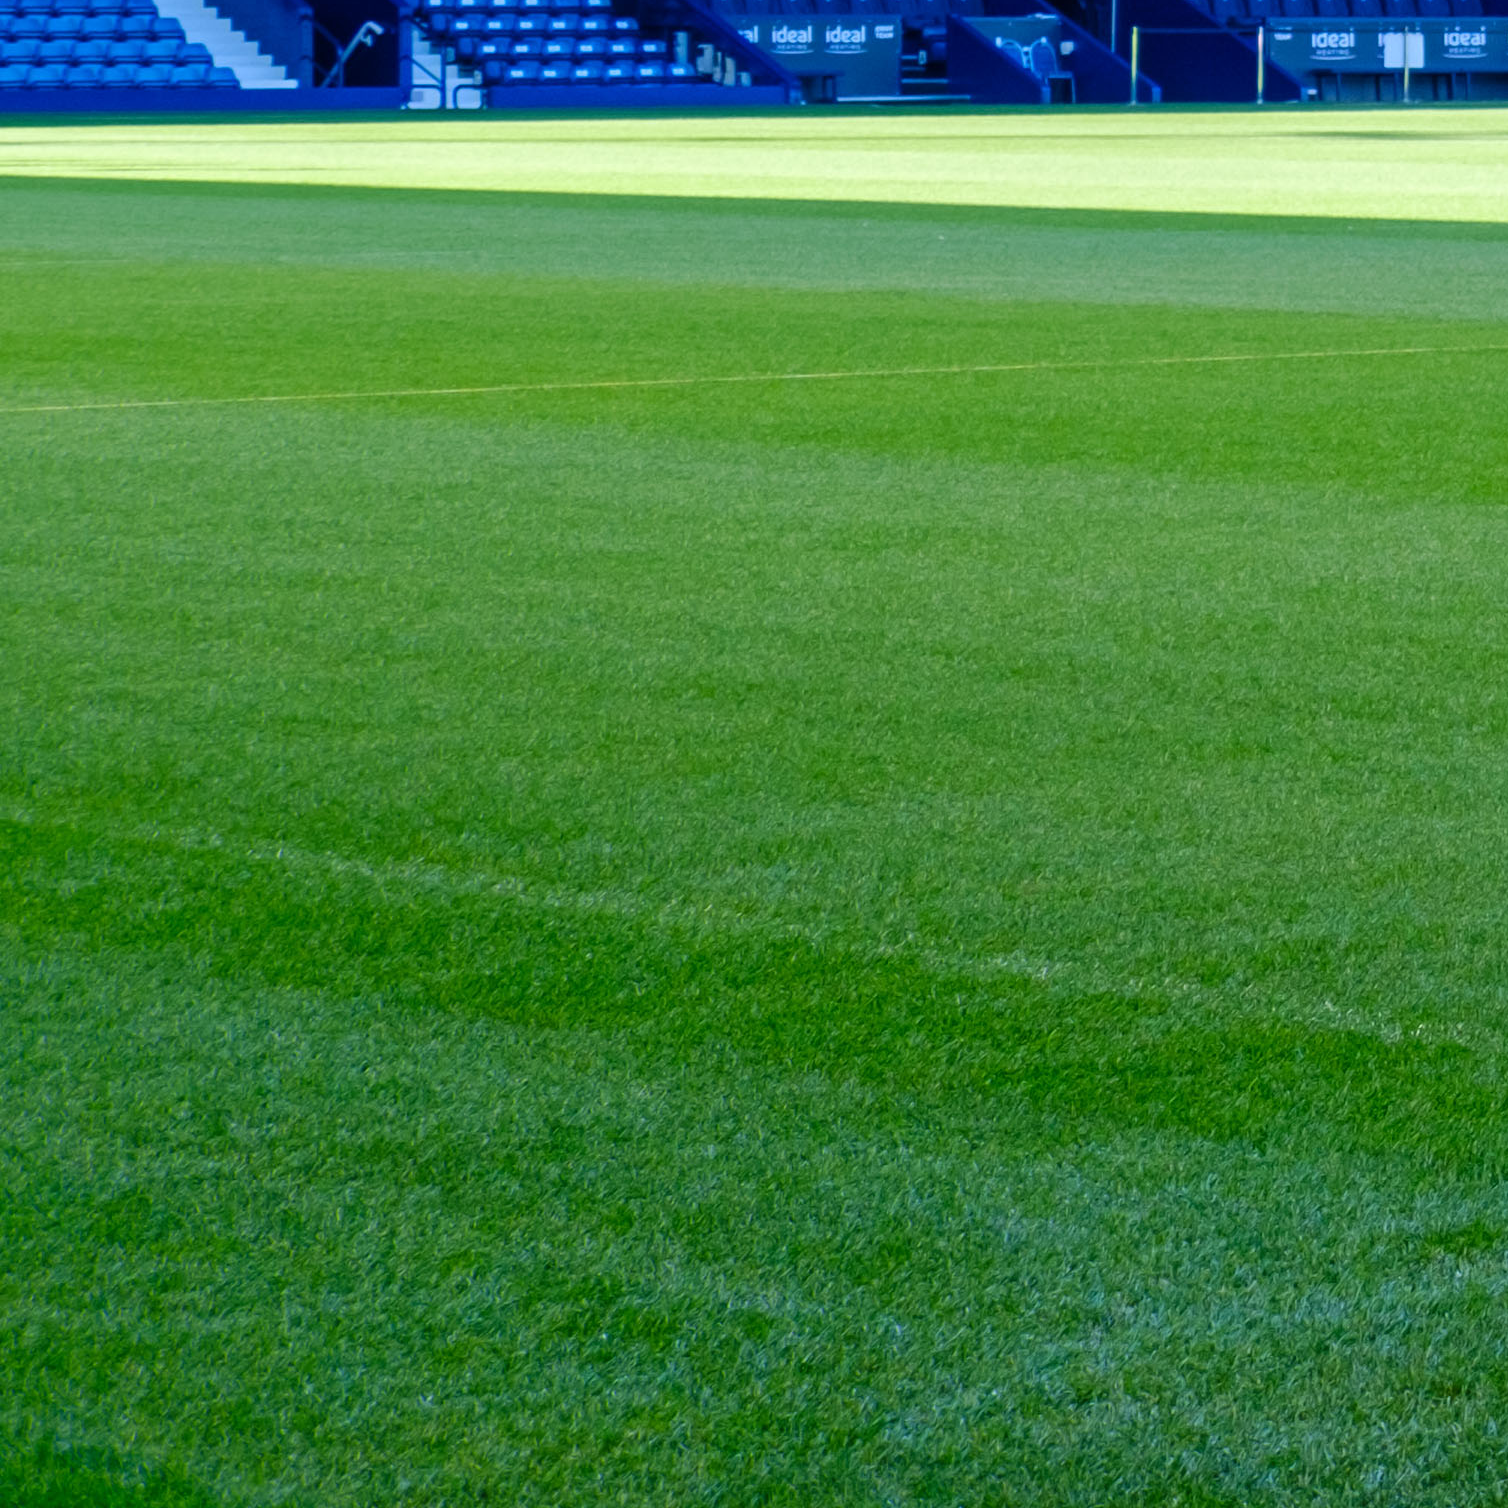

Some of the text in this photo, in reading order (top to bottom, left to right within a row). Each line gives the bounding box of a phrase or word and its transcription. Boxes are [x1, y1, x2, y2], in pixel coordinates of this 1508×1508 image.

[771, 25, 813, 43] ideal
[825, 25, 866, 43] ideal
[1311, 27, 1355, 48] ideal
[1443, 25, 1486, 48] ideal
